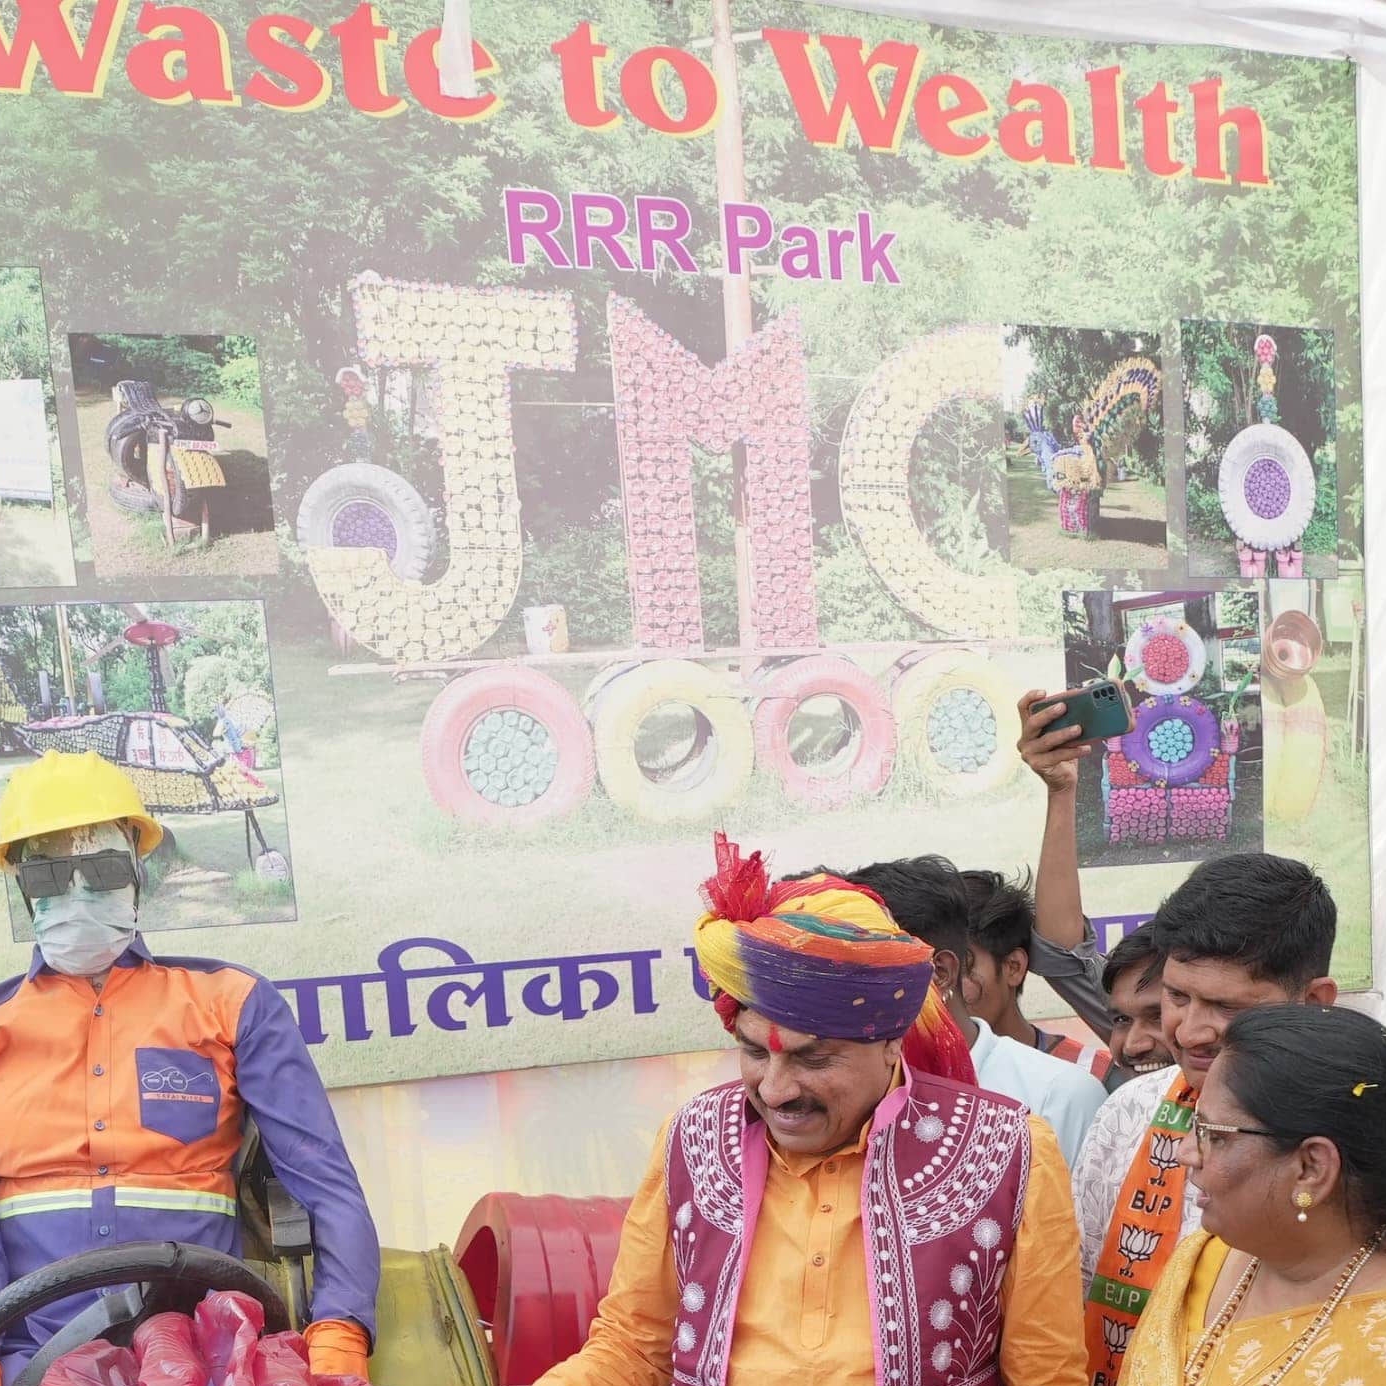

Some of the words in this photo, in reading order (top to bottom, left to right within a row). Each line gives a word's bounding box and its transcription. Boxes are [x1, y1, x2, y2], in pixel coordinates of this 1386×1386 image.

[550, 20, 719, 137] to
[762, 26, 1274, 188] Wealth
[503, 189, 699, 275] RRR
[721, 201, 902, 285] Park
[310, 270, 1016, 664] JMC
[1129, 1189, 1173, 1217] BJP
[1105, 1282, 1141, 1308] BJP
